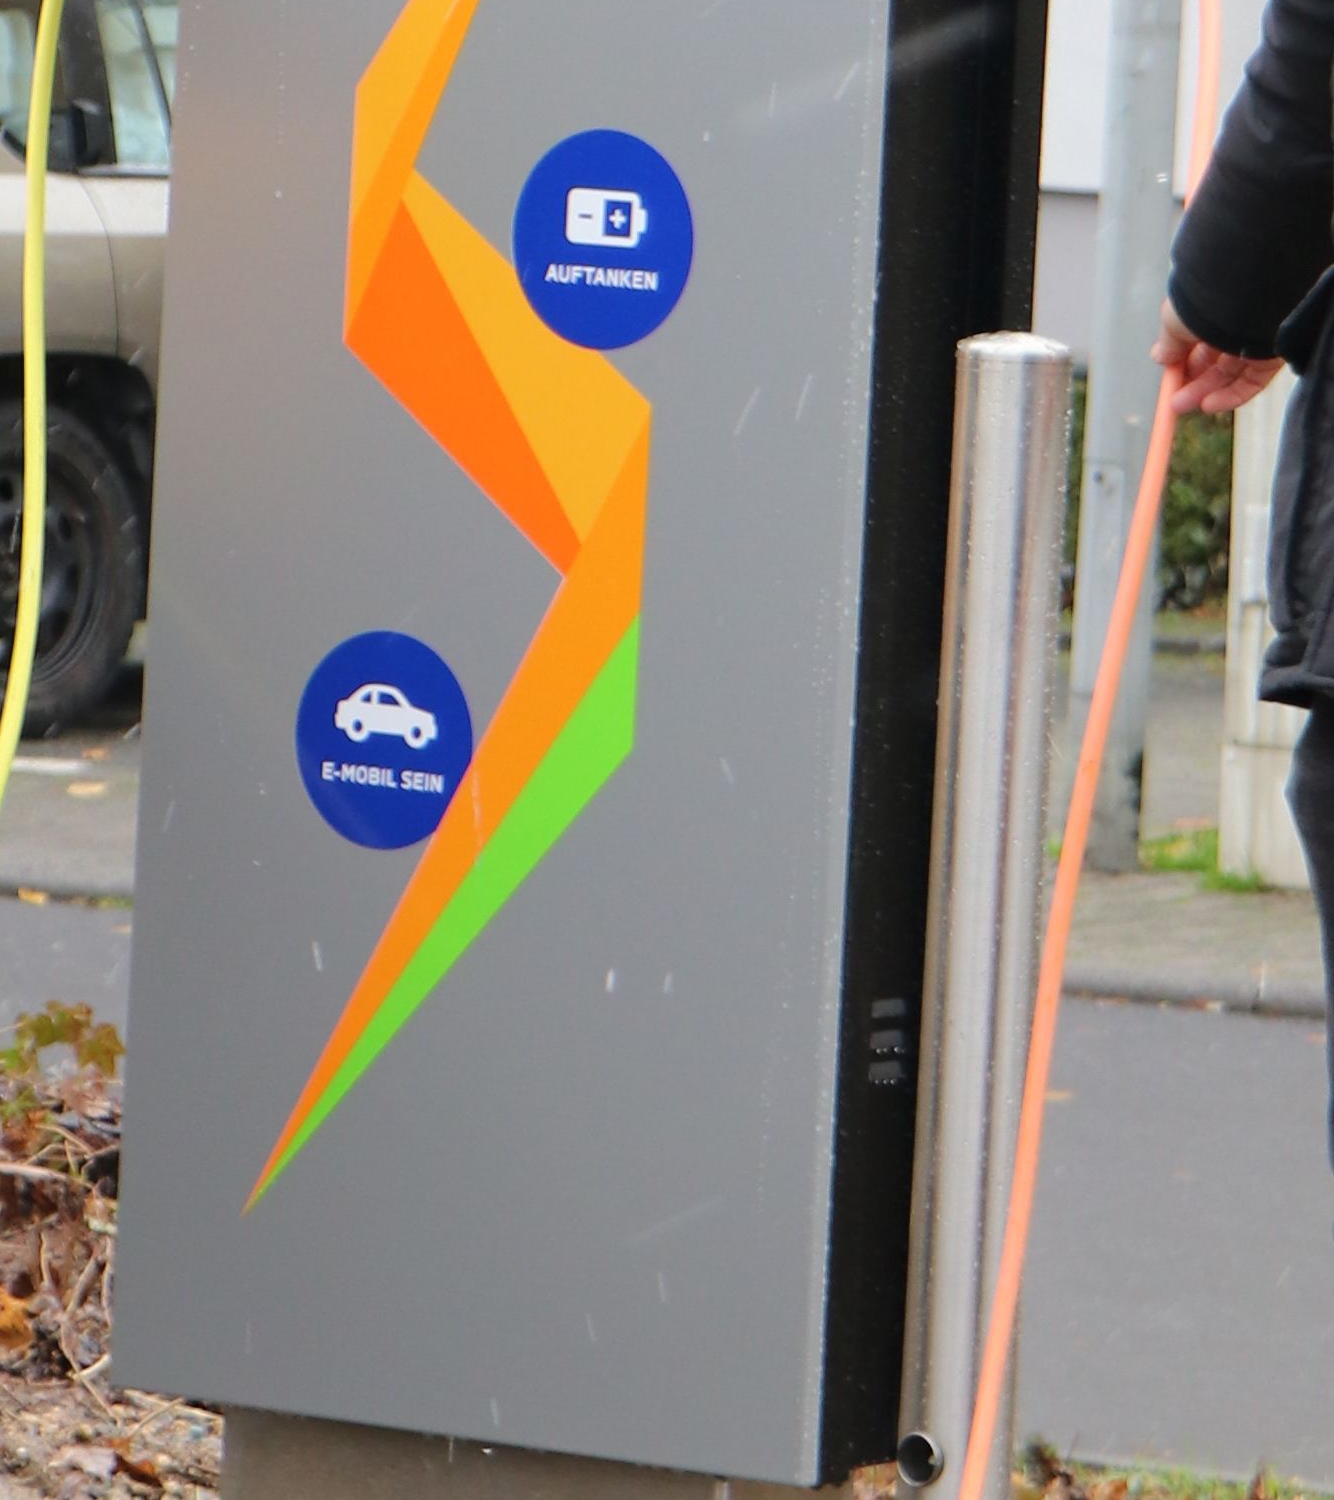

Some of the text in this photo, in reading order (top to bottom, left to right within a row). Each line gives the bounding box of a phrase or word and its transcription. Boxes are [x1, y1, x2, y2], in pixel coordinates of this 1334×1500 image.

[544, 263, 659, 292] AUFTANKEN
[321, 760, 445, 794] E-MOBIL SEIN
